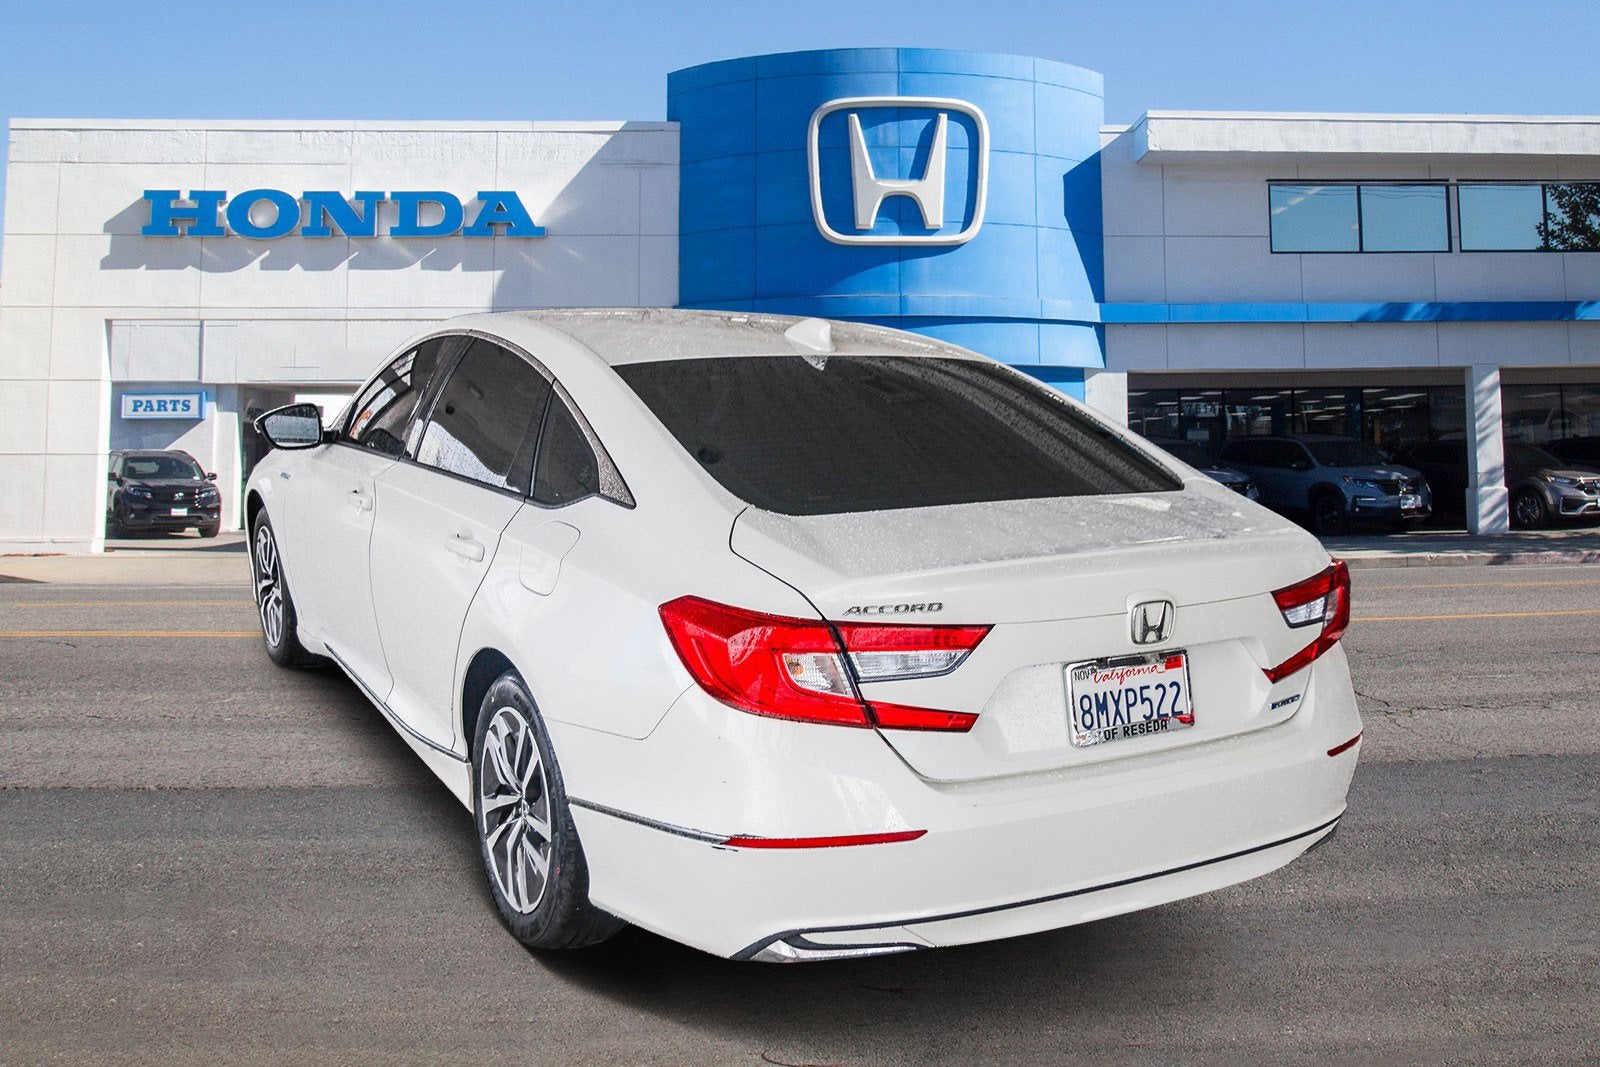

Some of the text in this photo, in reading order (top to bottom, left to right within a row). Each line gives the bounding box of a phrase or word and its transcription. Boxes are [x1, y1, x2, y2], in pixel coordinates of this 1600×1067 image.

[142, 188, 548, 240] HONDA
[132, 399, 192, 413] PARTS
[842, 602, 944, 616] ACCORD
[1093, 664, 1166, 685] California
[1079, 681, 1184, 731] 8MXP522
[1103, 718, 1168, 741] OF RESEDA
